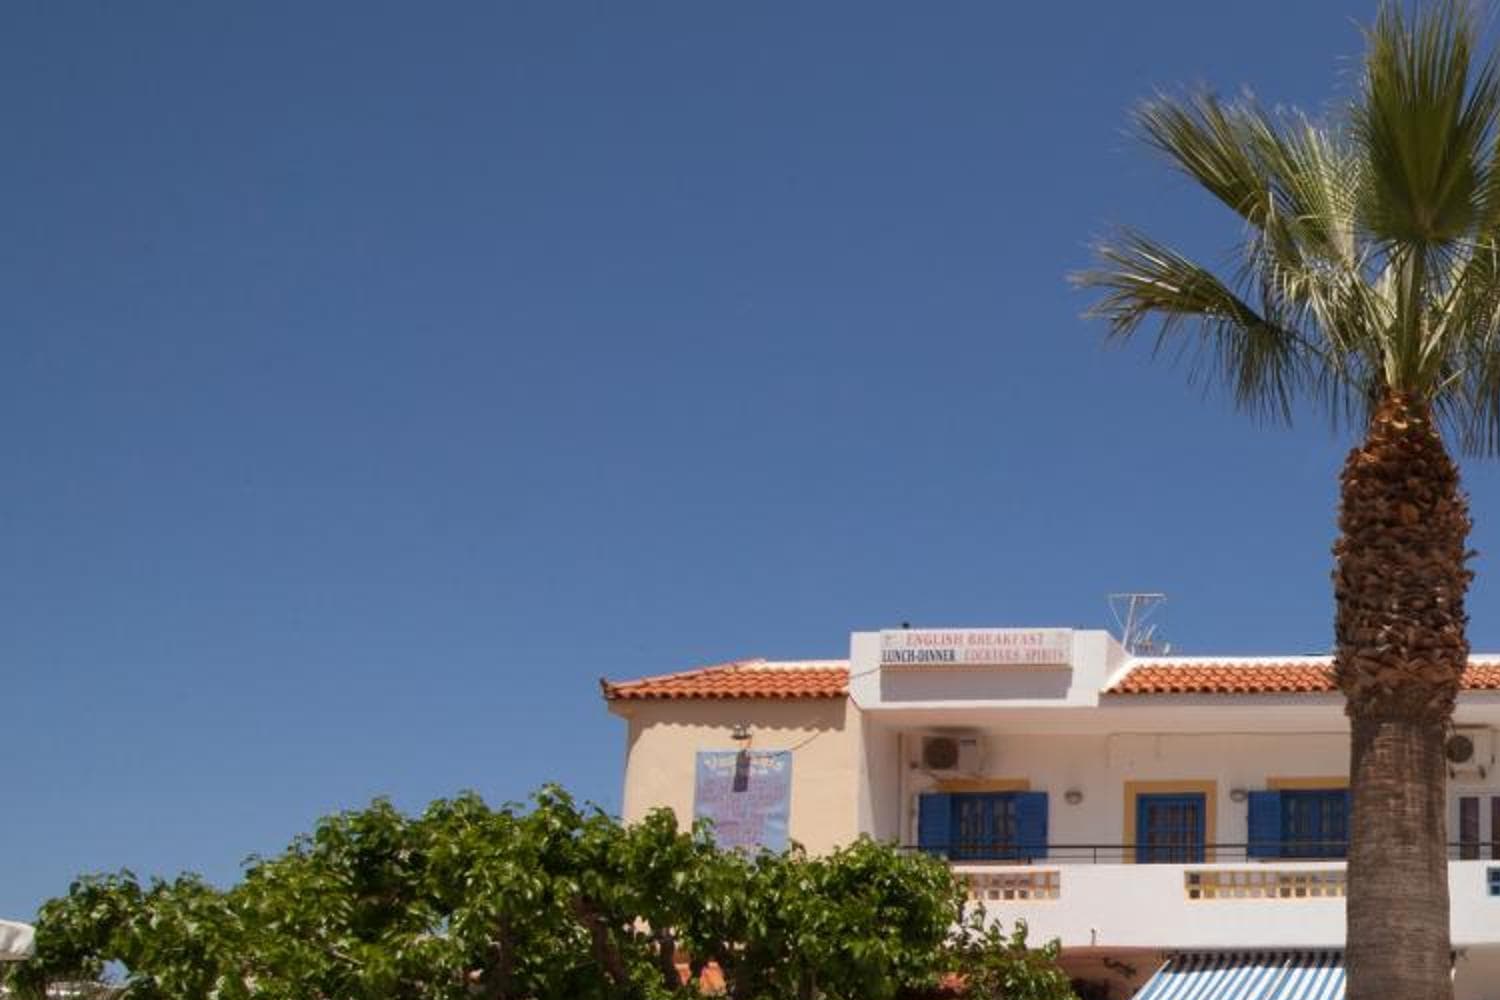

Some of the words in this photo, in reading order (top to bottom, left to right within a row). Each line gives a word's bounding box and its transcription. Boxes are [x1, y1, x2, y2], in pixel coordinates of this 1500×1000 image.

[906, 632, 964, 646] ENGLISH
[967, 631, 1044, 646] BREAKFAST
[882, 649, 956, 662] LUNCH-DINNER
